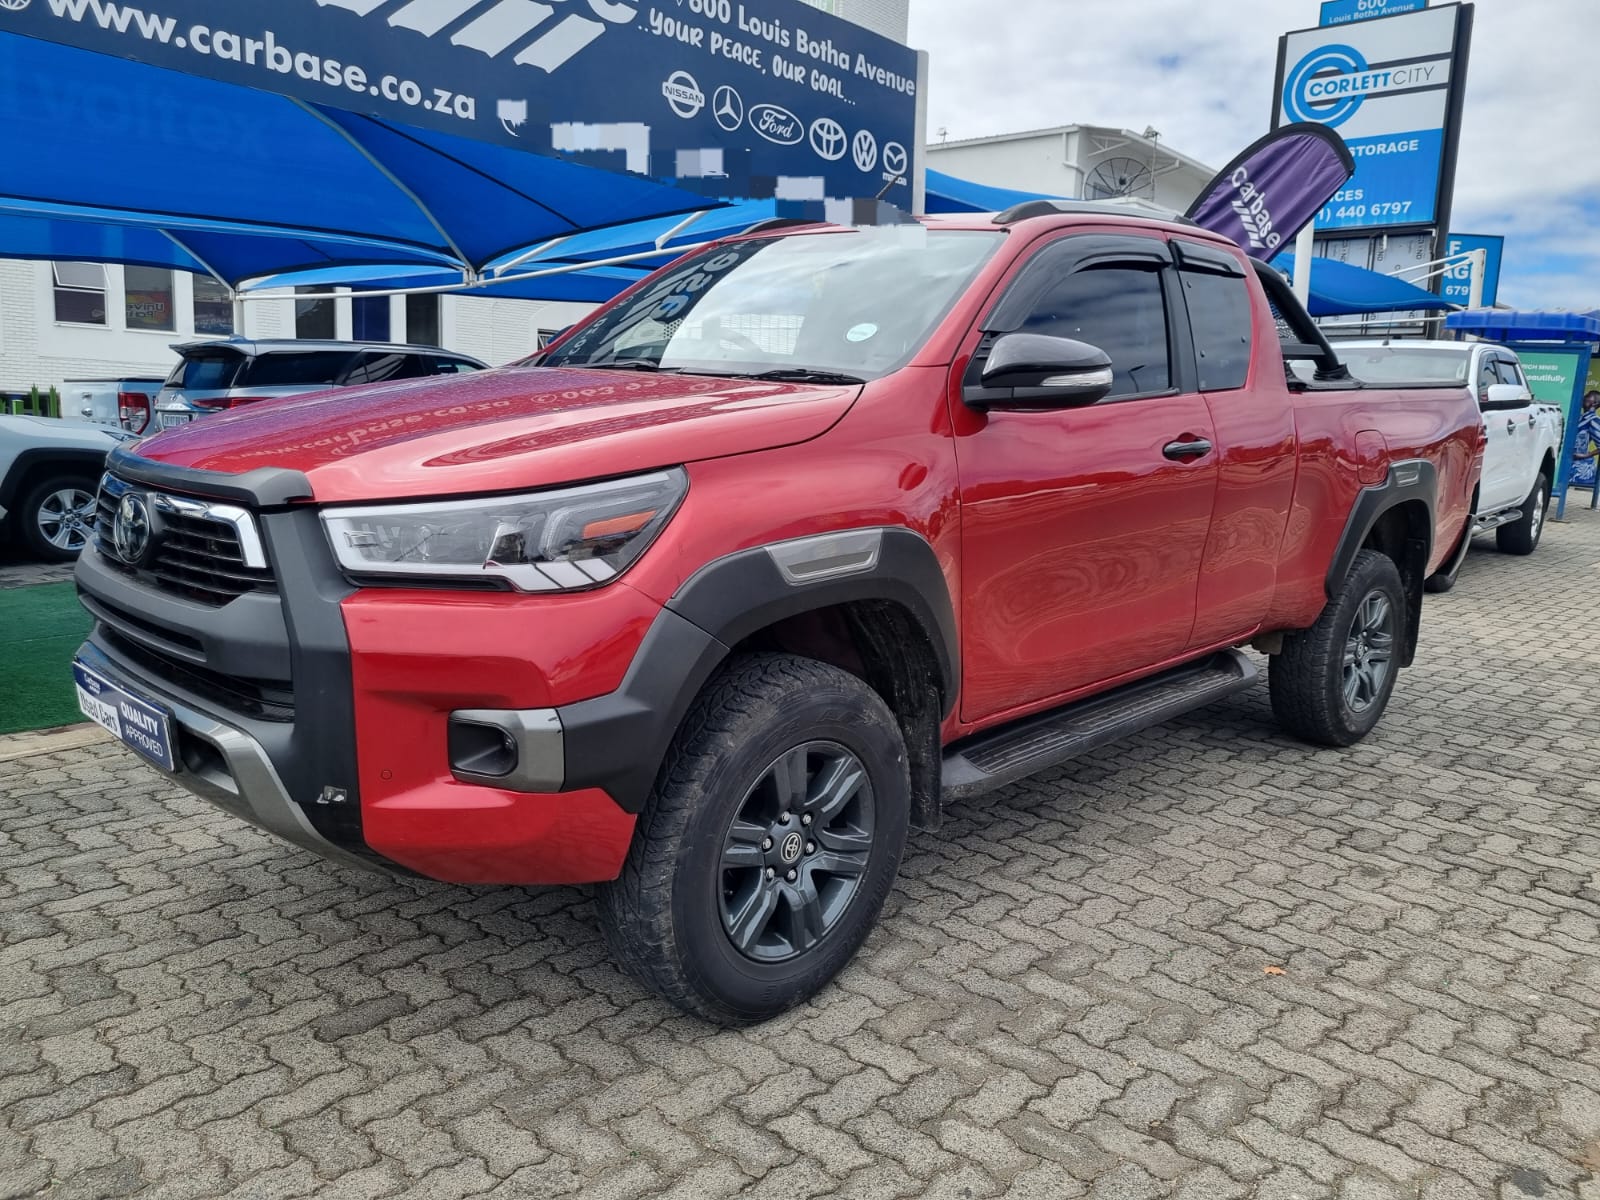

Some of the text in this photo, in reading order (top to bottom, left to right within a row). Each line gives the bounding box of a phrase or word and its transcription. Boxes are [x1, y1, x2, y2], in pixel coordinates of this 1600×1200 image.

[1329, 3, 1415, 24] Louis Botha Avenue
[1357, 0, 1386, 10] 600
[46, 0, 477, 119] www.carbase.co.za
[738, 6, 790, 48] Louis
[796, 29, 850, 71] Botha
[854, 53, 915, 96] Avenue
[772, 55, 804, 84] OUR
[664, 85, 703, 103] NISSAN
[759, 109, 794, 139] Ford
[1231, 166, 1280, 248] Carbase
[1333, 189, 1363, 202] CES
[1336, 205, 1365, 218] 440
[1370, 201, 1411, 216] 6797
[1446, 286, 1469, 295] 679
[120, 701, 159, 736] QUALITY
[126, 724, 164, 757] APPROVED
